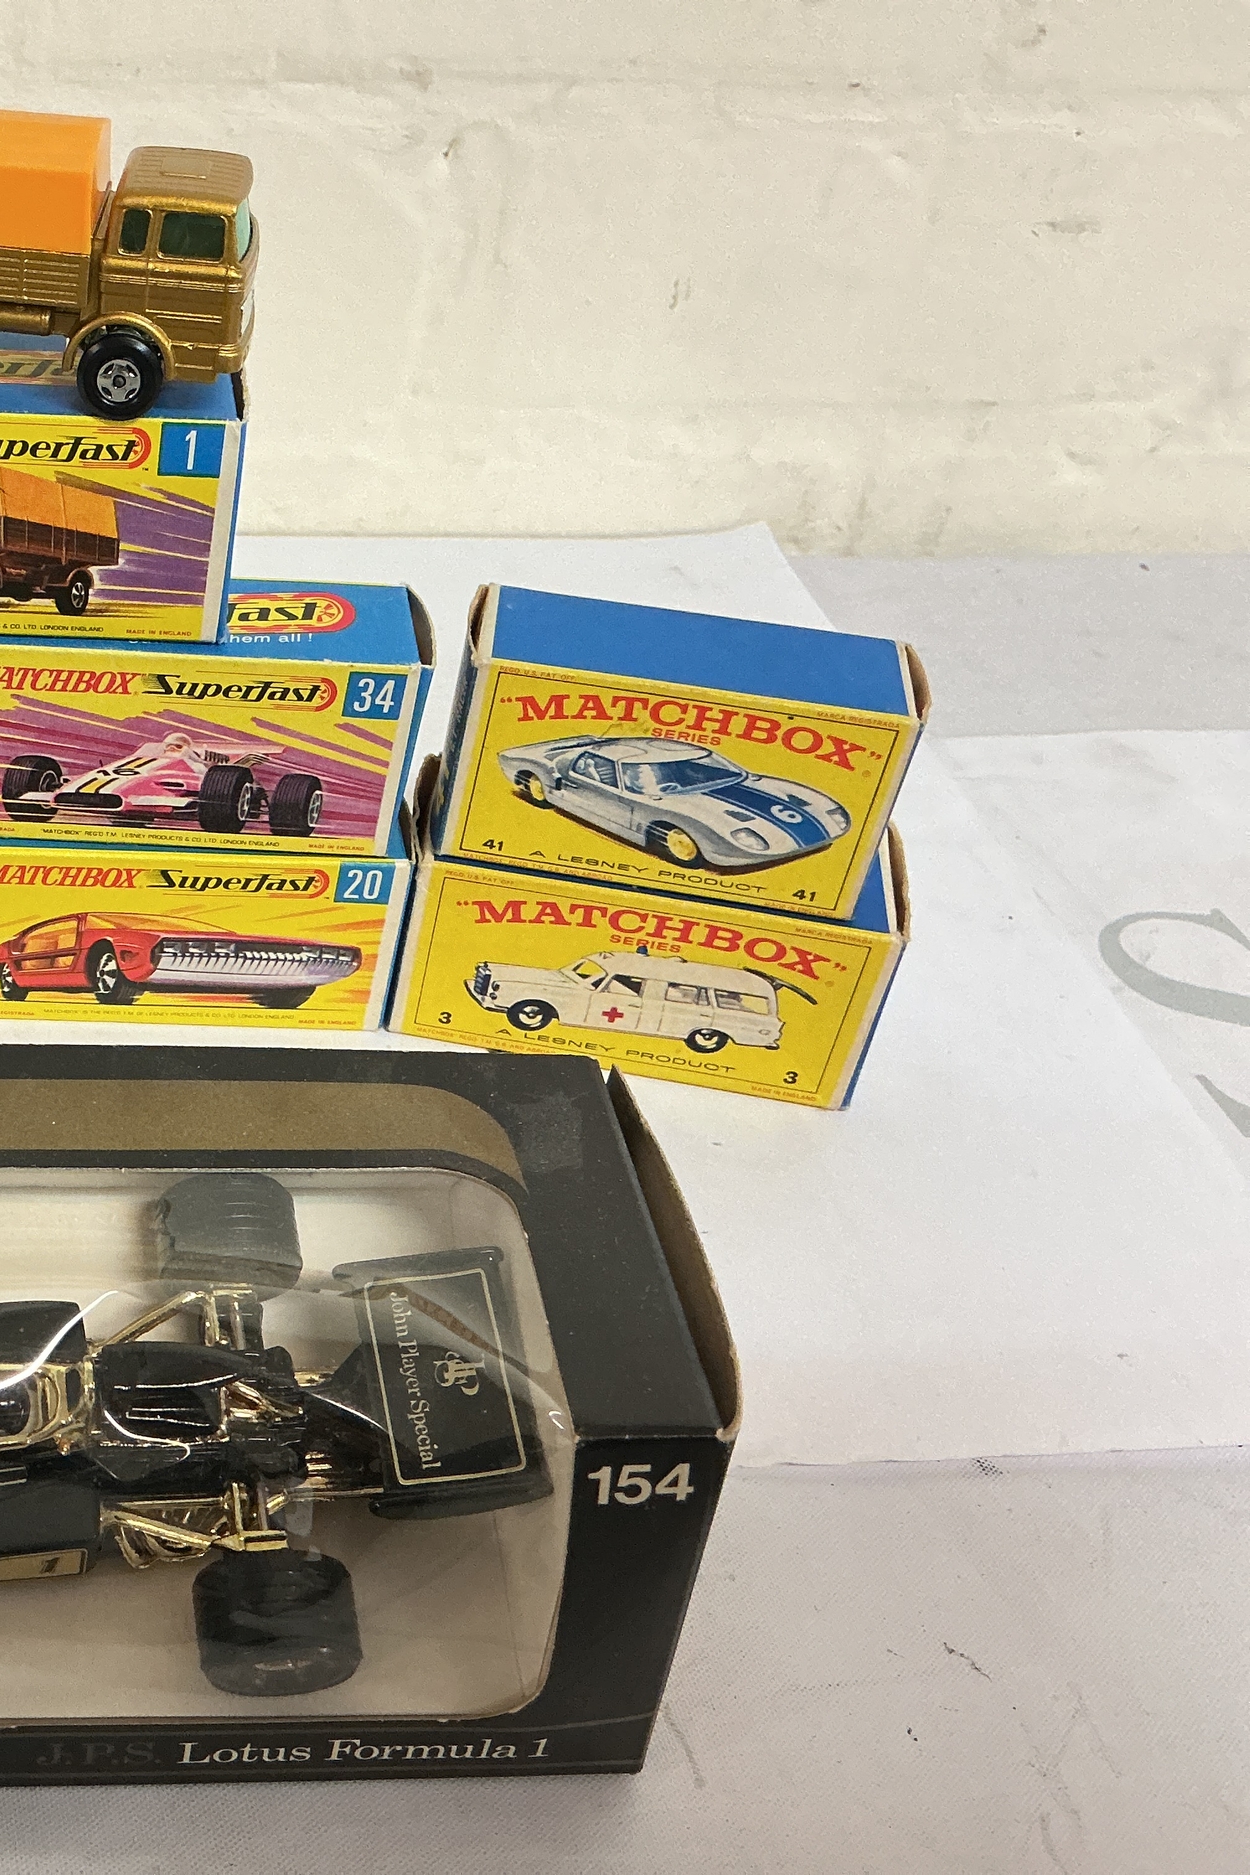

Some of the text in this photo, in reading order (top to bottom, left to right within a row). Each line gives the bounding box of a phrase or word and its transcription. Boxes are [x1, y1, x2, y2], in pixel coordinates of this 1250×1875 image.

[184, 429, 198, 471] 1
[225, 633, 271, 644] hem
[279, 634, 301, 643] all
[142, 673, 324, 703] Superfast
[353, 678, 396, 714] 34
[651, 727, 722, 747] SERIES
[482, 838, 504, 852] 41
[146, 869, 317, 893] Superfast
[343, 869, 383, 900] 20
[529, 850, 768, 894] A LESNEY PRODUCT
[792, 888, 817, 903] 41
[609, 934, 682, 954] SERIES
[438, 1011, 452, 1025] 3
[496, 1028, 736, 1074] A LESNEY PRODUCT
[783, 1070, 799, 1085] 3
[390, 1291, 442, 1471] John Player Special
[587, 1462, 695, 1506] 154
[176, 1738, 312, 1765] Lotus
[323, 1737, 518, 1763] Formula
[528, 1737, 550, 1758] 1
